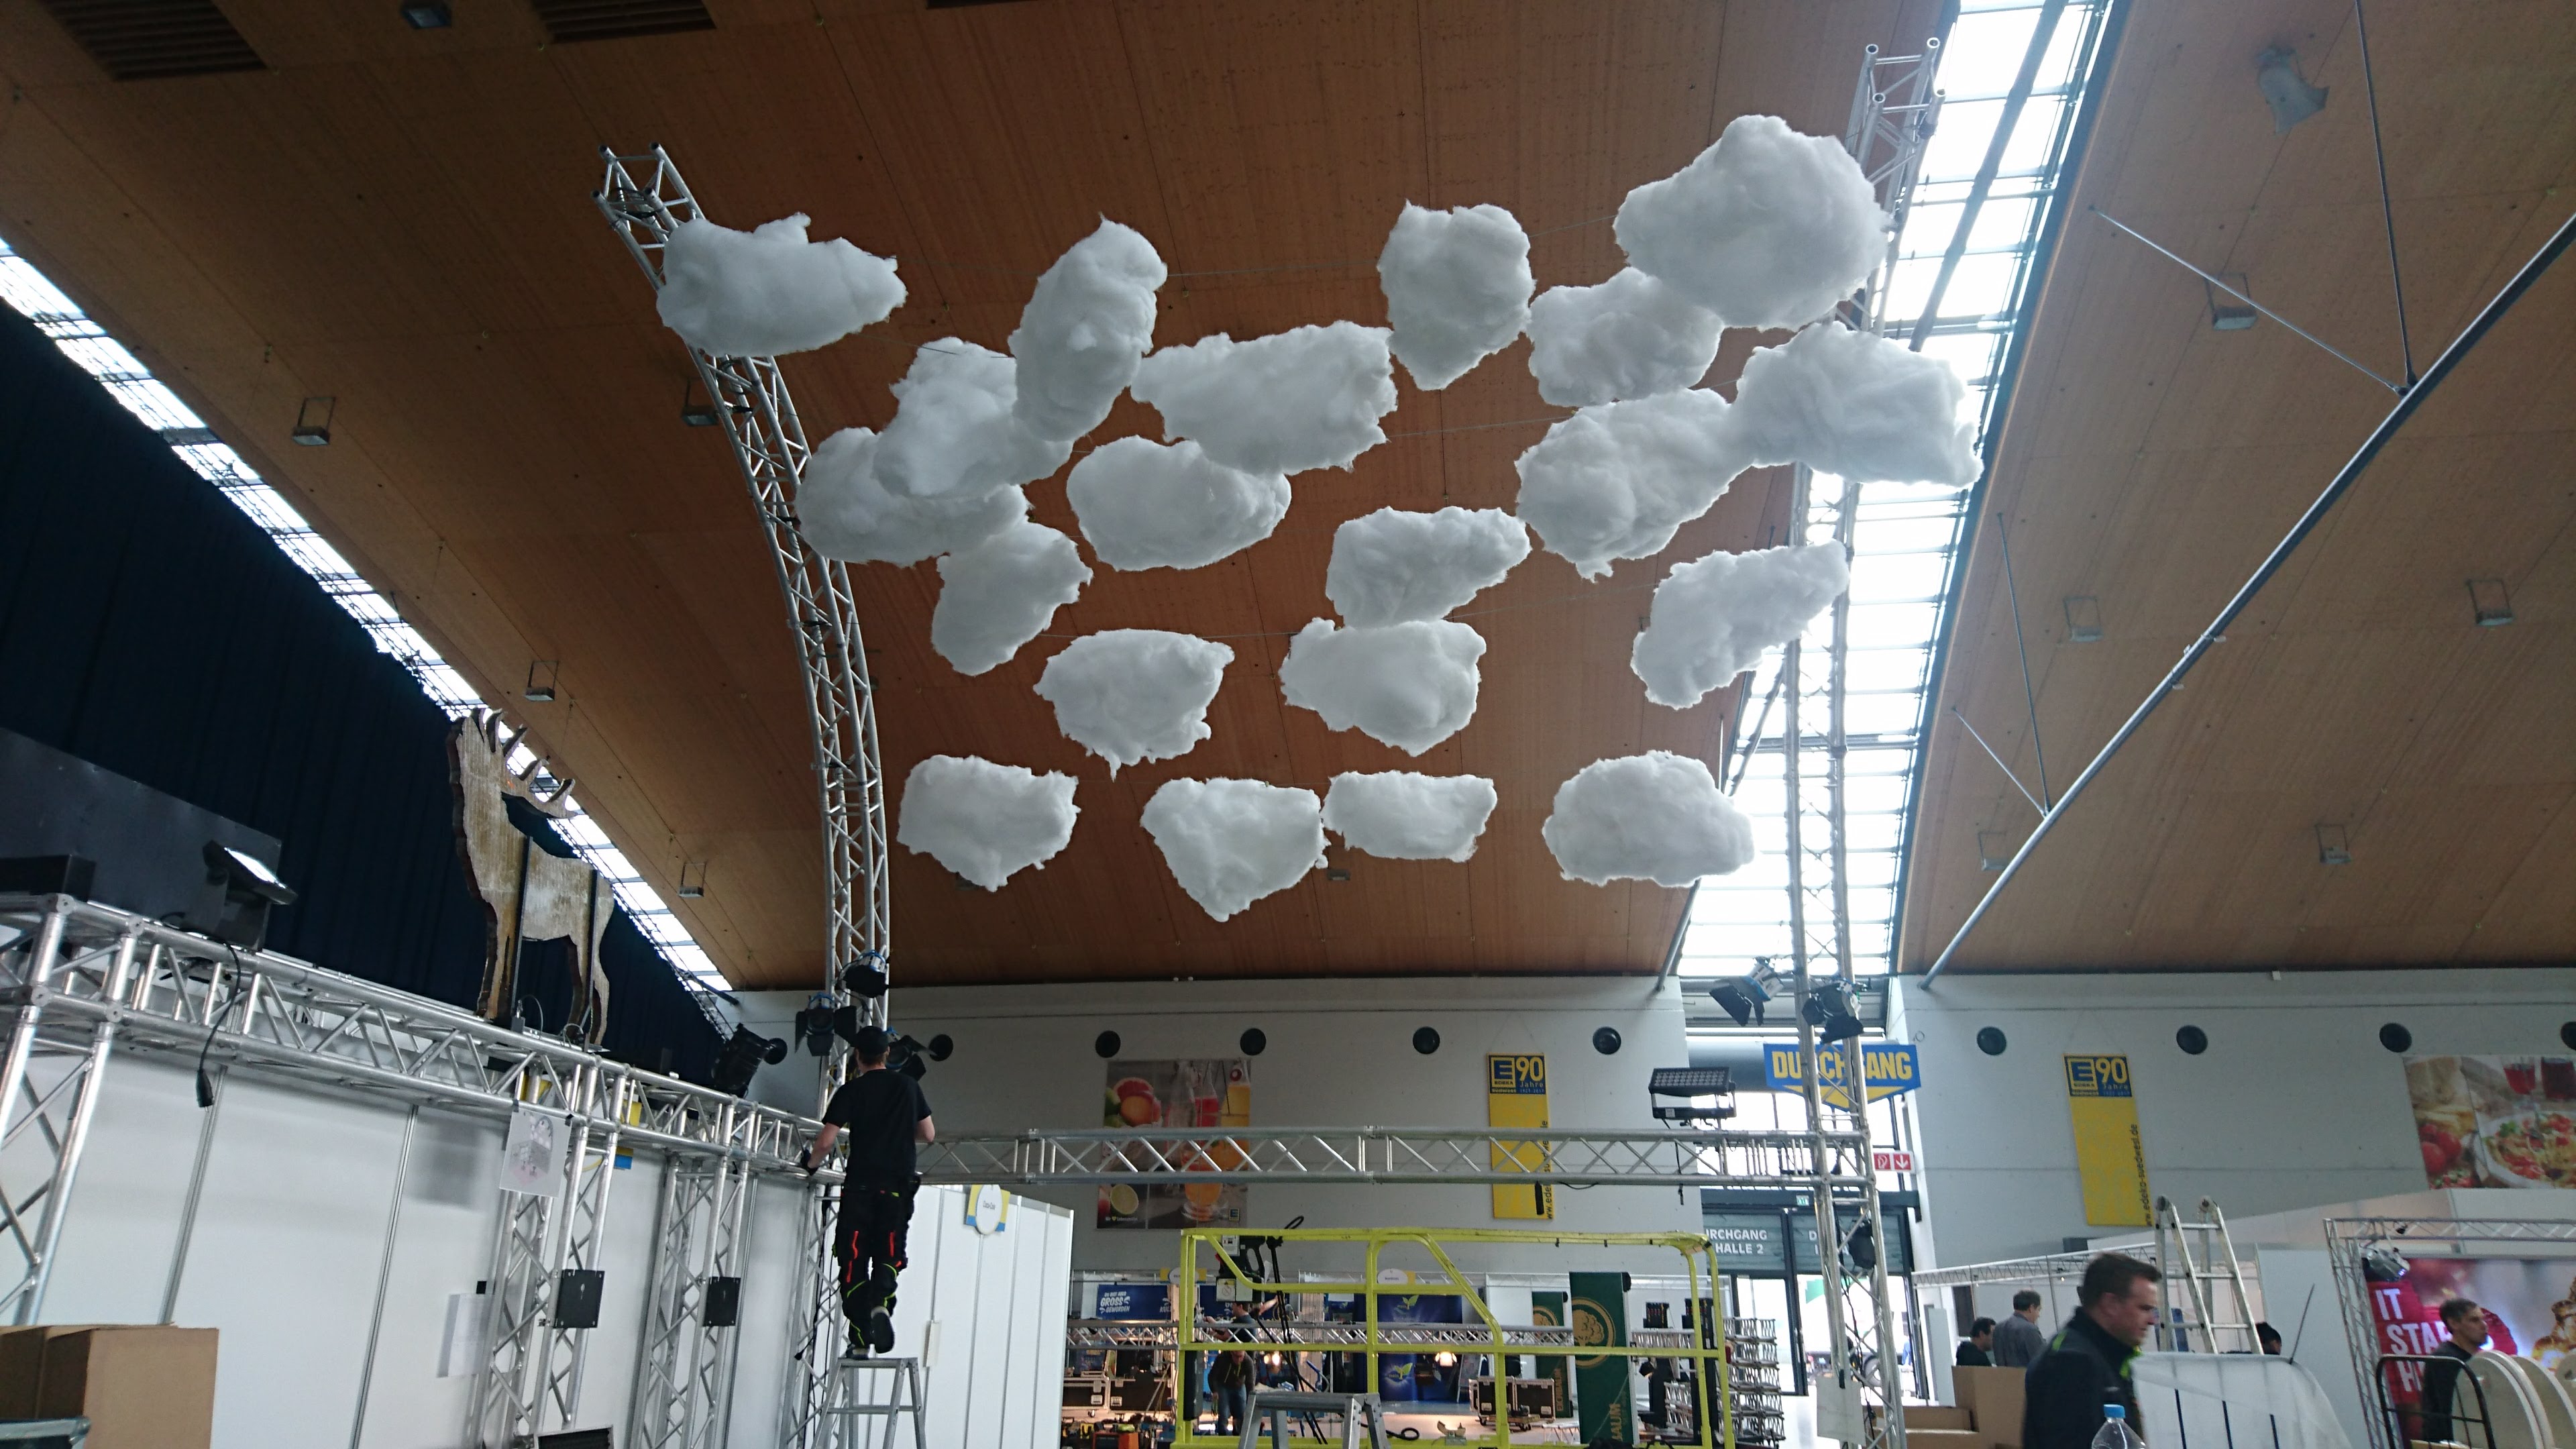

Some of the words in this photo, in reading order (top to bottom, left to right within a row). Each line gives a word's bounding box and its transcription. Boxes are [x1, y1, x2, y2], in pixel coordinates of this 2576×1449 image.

[1516, 1057, 1544, 1081] 90
[1772, 1051, 1913, 1079] DUCHANG
[2096, 1058, 2127, 1083] 90
[1715, 1244, 1753, 1254] HALLE
[1756, 1244, 1764, 1254] 2
[1100, 1297, 1124, 1307] GROSS
[2375, 1288, 2403, 1320] IT
